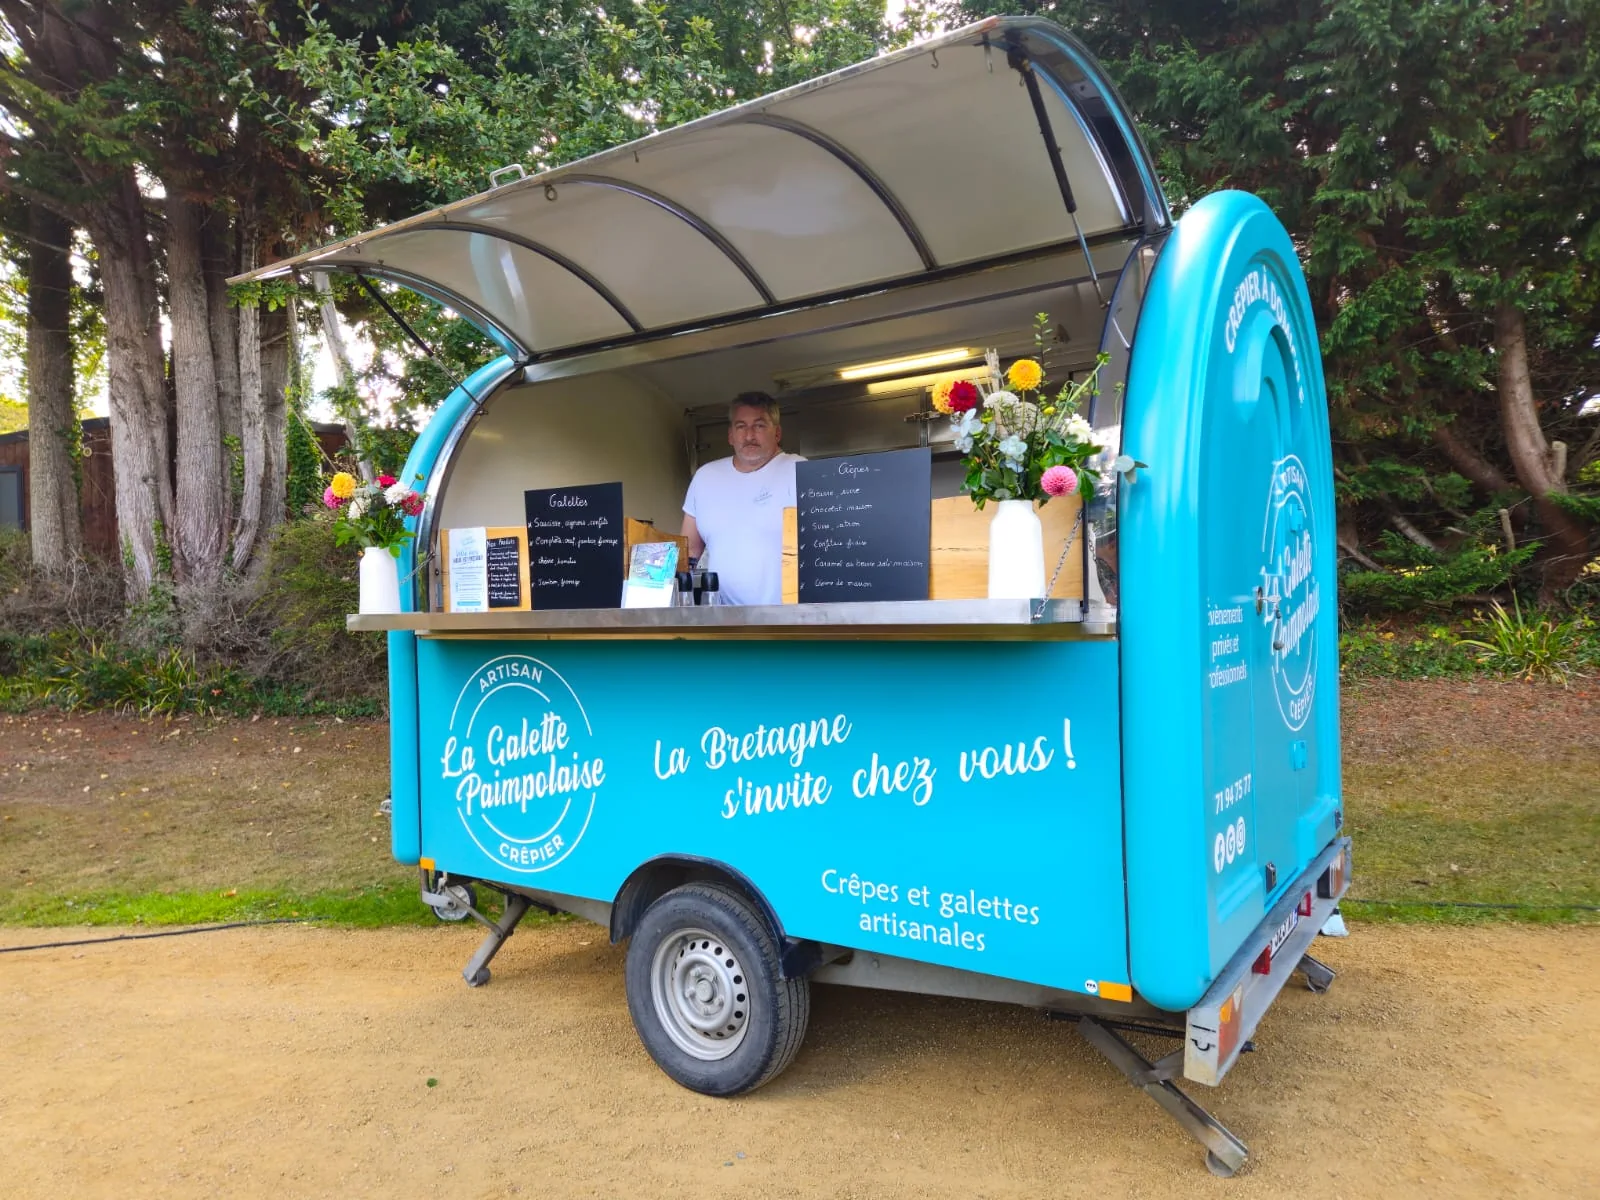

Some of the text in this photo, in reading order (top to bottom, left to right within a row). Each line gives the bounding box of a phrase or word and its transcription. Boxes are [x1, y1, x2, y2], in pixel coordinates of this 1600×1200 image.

[549, 493, 588, 508] Galettes
[478, 662, 544, 693] ARTISAN
[440, 711, 570, 779] La Galette
[654, 713, 853, 780] La Bretagne
[720, 717, 1077, 820] s'invite chez vous !
[456, 752, 607, 816] Paimpolaise
[498, 833, 565, 865] CRÊPIER
[821, 868, 1041, 926] Crêpes et galettes
[858, 910, 987, 952] artisanales
